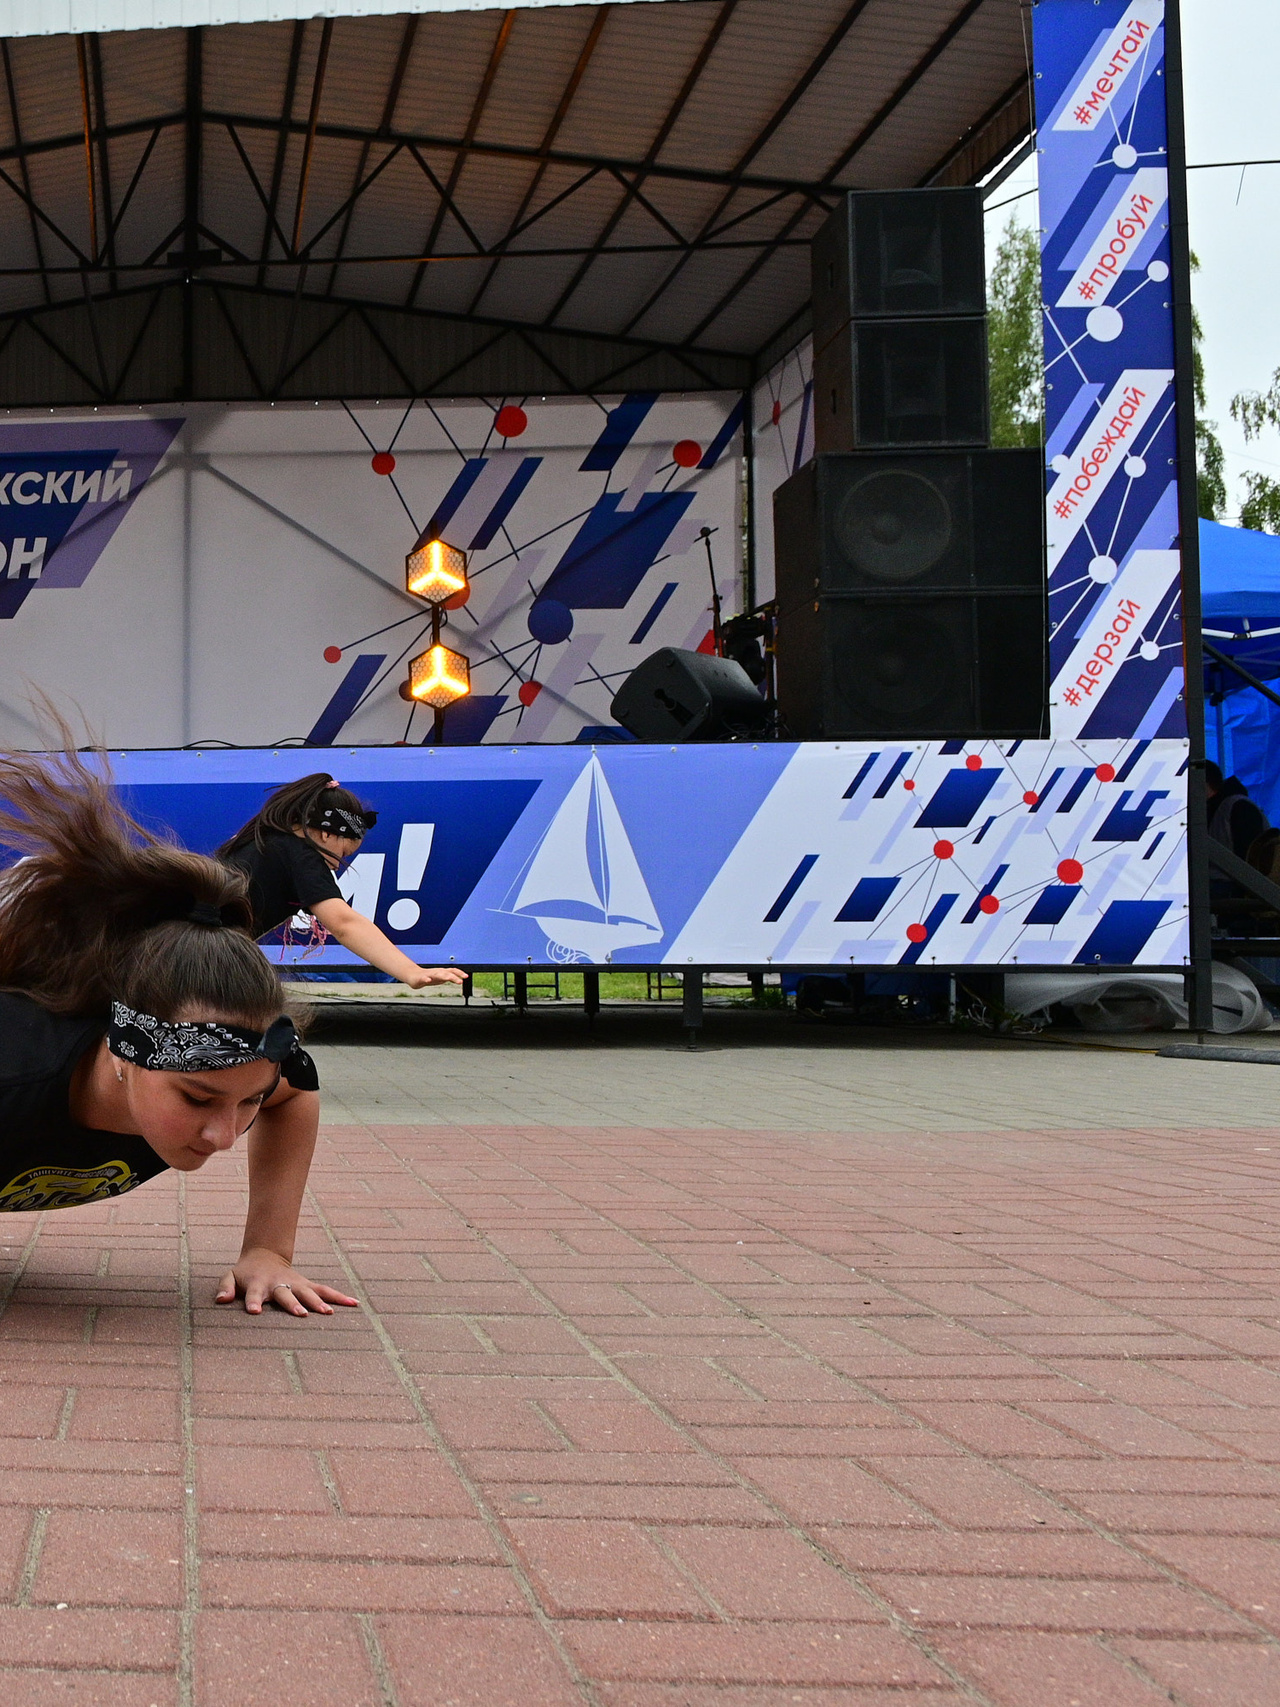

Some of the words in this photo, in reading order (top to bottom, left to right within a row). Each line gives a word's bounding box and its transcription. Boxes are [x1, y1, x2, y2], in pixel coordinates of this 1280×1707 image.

[1073, 20, 1150, 125] #мечтай
[1078, 193, 1154, 301] #пробуй
[1053, 386, 1146, 519] #побеждай
[1063, 599, 1141, 707] #дерзай
